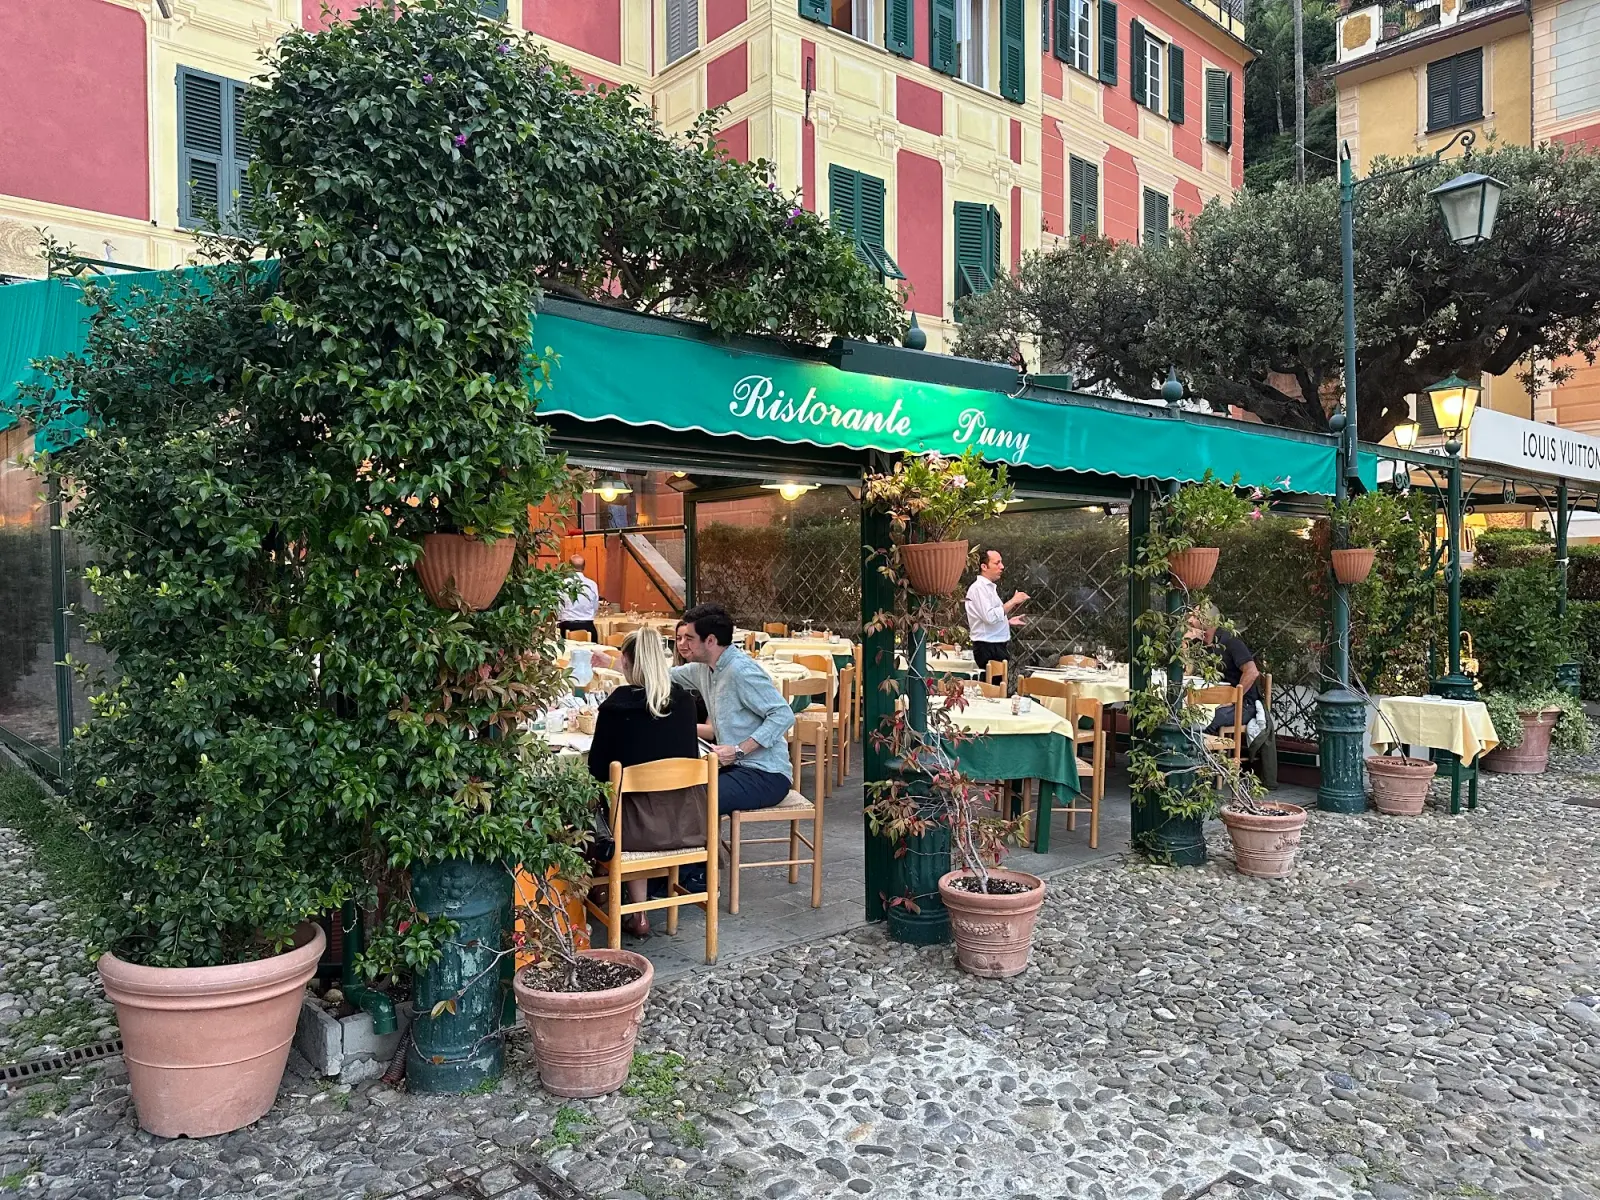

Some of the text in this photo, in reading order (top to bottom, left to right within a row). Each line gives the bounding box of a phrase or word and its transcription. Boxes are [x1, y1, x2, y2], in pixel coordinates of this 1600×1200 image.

[729, 374, 1031, 464] Ristorante Puny
[1523, 431, 1556, 462] LOUIS
